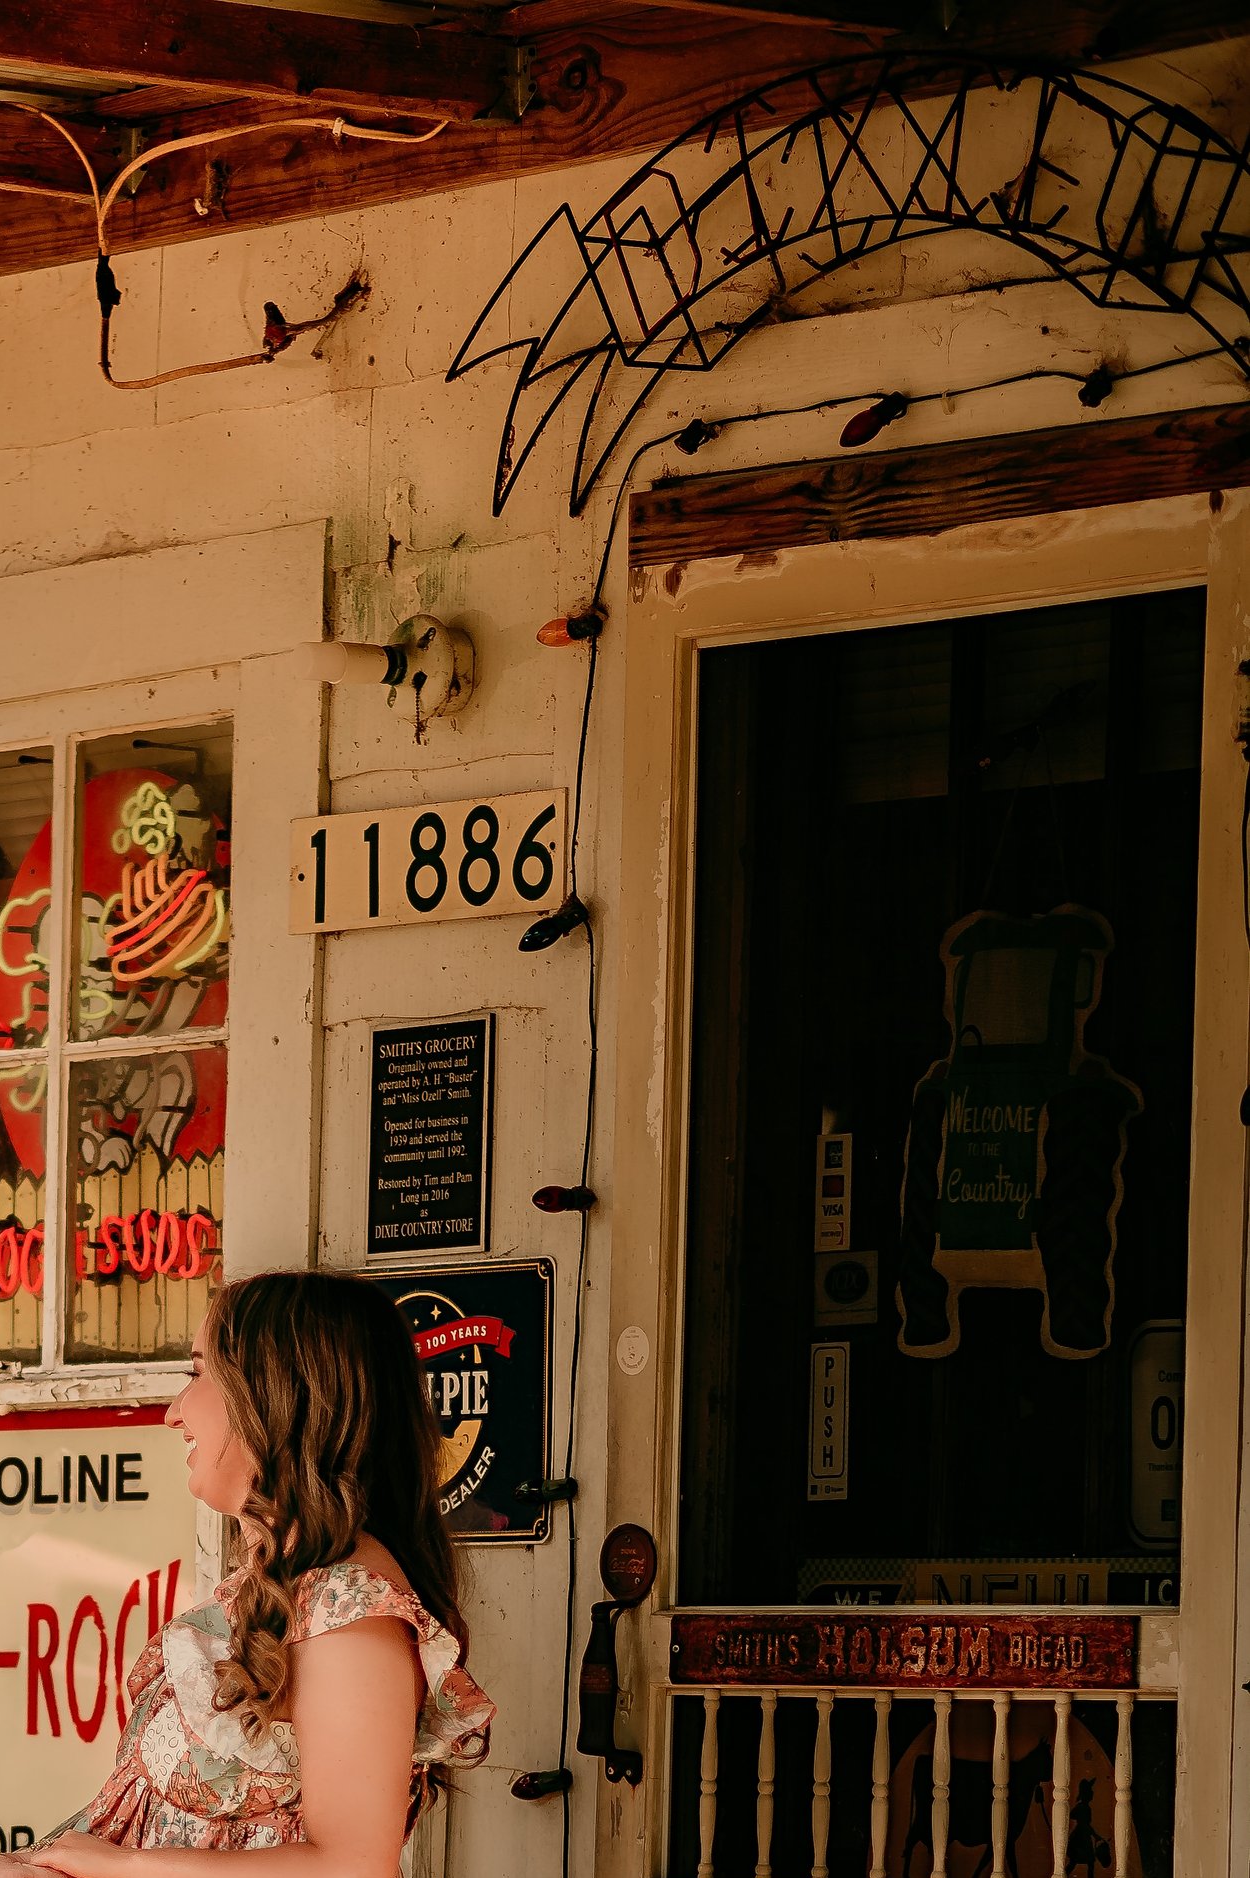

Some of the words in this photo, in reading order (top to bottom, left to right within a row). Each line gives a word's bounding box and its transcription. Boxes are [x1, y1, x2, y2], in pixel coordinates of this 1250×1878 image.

[310, 802, 557, 924] 11886
[380, 1041, 422, 1059] SMITH'S
[425, 1035, 477, 1054] GROCERY
[388, 1060, 425, 1076] Originally
[427, 1057, 452, 1070] owned
[454, 1055, 468, 1067] and
[378, 1077, 410, 1093] operated
[412, 1076, 421, 1090] by
[383, 1094, 396, 1106] and
[447, 1086, 472, 1100] Smith.
[950, 1085, 1036, 1133] WELCOME
[384, 1119, 412, 1134] Opened
[414, 1117, 426, 1129] for
[428, 1116, 459, 1128] business
[461, 1114, 469, 1125] in
[409, 1133, 423, 1145] and
[424, 1131, 449, 1144] served
[451, 1130, 463, 1141] the
[384, 1149, 425, 1162] community
[428, 1147, 445, 1159] until
[378, 1176, 410, 1190] Restored
[412, 1175, 421, 1189] by
[424, 1174, 439, 1186] Tim
[440, 1172, 454, 1184] and
[456, 1172, 473, 1183] Pam
[947, 1163, 1032, 1220] Country
[400, 1192, 420, 1205] Long
[421, 1191, 429, 1202] in
[431, 1189, 450, 1201] 2016
[420, 1209, 429, 1218] as
[822, 1204, 844, 1217] VISA
[375, 1223, 400, 1239] DIXIE
[401, 1220, 444, 1237] COUNTRY
[445, 1218, 474, 1234] STORE
[97, 1208, 211, 1279] SUDS
[426, 1333, 447, 1349] 100
[450, 1324, 487, 1343] YEARS
[440, 1369, 490, 1417] PIE
[822, 1356, 835, 1468] PUSH
[439, 1445, 496, 1516] DEALER
[715, 1633, 799, 1666] SMITH'S
[815, 1624, 991, 1679] HOLSUM
[1010, 1635, 1087, 1669] BREAD
